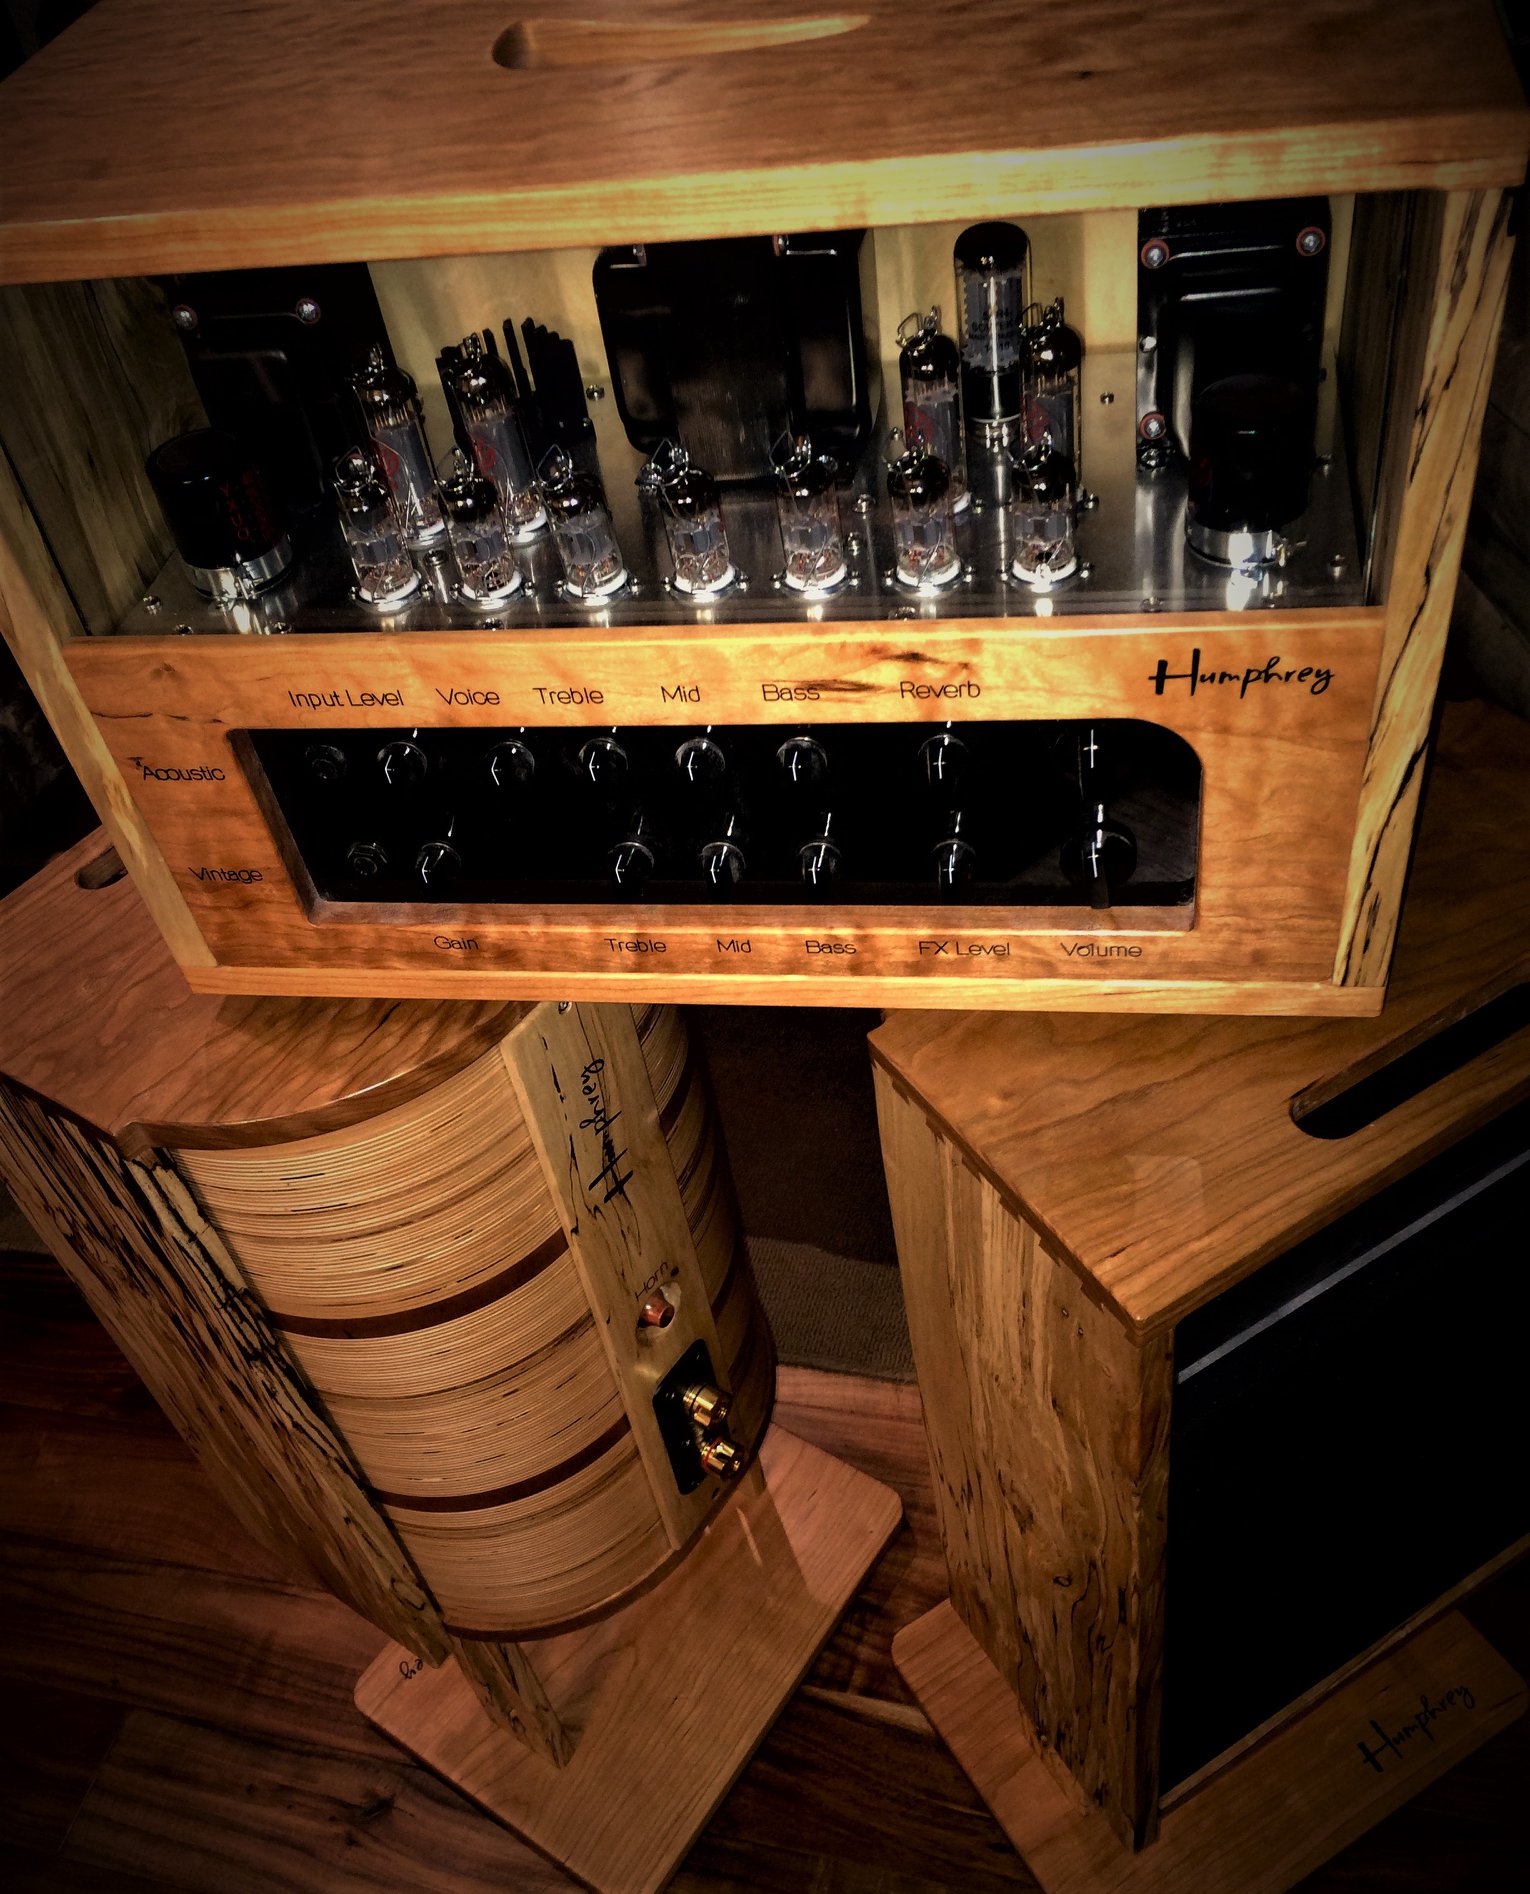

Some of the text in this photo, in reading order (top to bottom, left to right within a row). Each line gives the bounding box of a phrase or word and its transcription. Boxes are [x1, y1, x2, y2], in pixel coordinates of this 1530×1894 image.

[1148, 648, 1336, 698] Humphrey
[436, 687, 501, 706] Voice
[533, 687, 604, 705] Treble
[660, 685, 701, 703] Mid
[762, 683, 821, 702] Bass
[900, 681, 981, 699] Reverb
[288, 689, 404, 711] Input Level
[143, 765, 226, 781] Acoustic
[191, 866, 263, 884] Vintage
[433, 935, 479, 951] Gain
[604, 938, 667, 953] Treble
[717, 939, 752, 954] Mid
[805, 940, 857, 955] Bass
[919, 941, 1011, 956] FX Level
[1060, 942, 1143, 958] Volume
[579, 1058, 634, 1204] Humphrey
[635, 1260, 669, 1302] Horn
[1357, 1685, 1475, 1773] Humphrey
